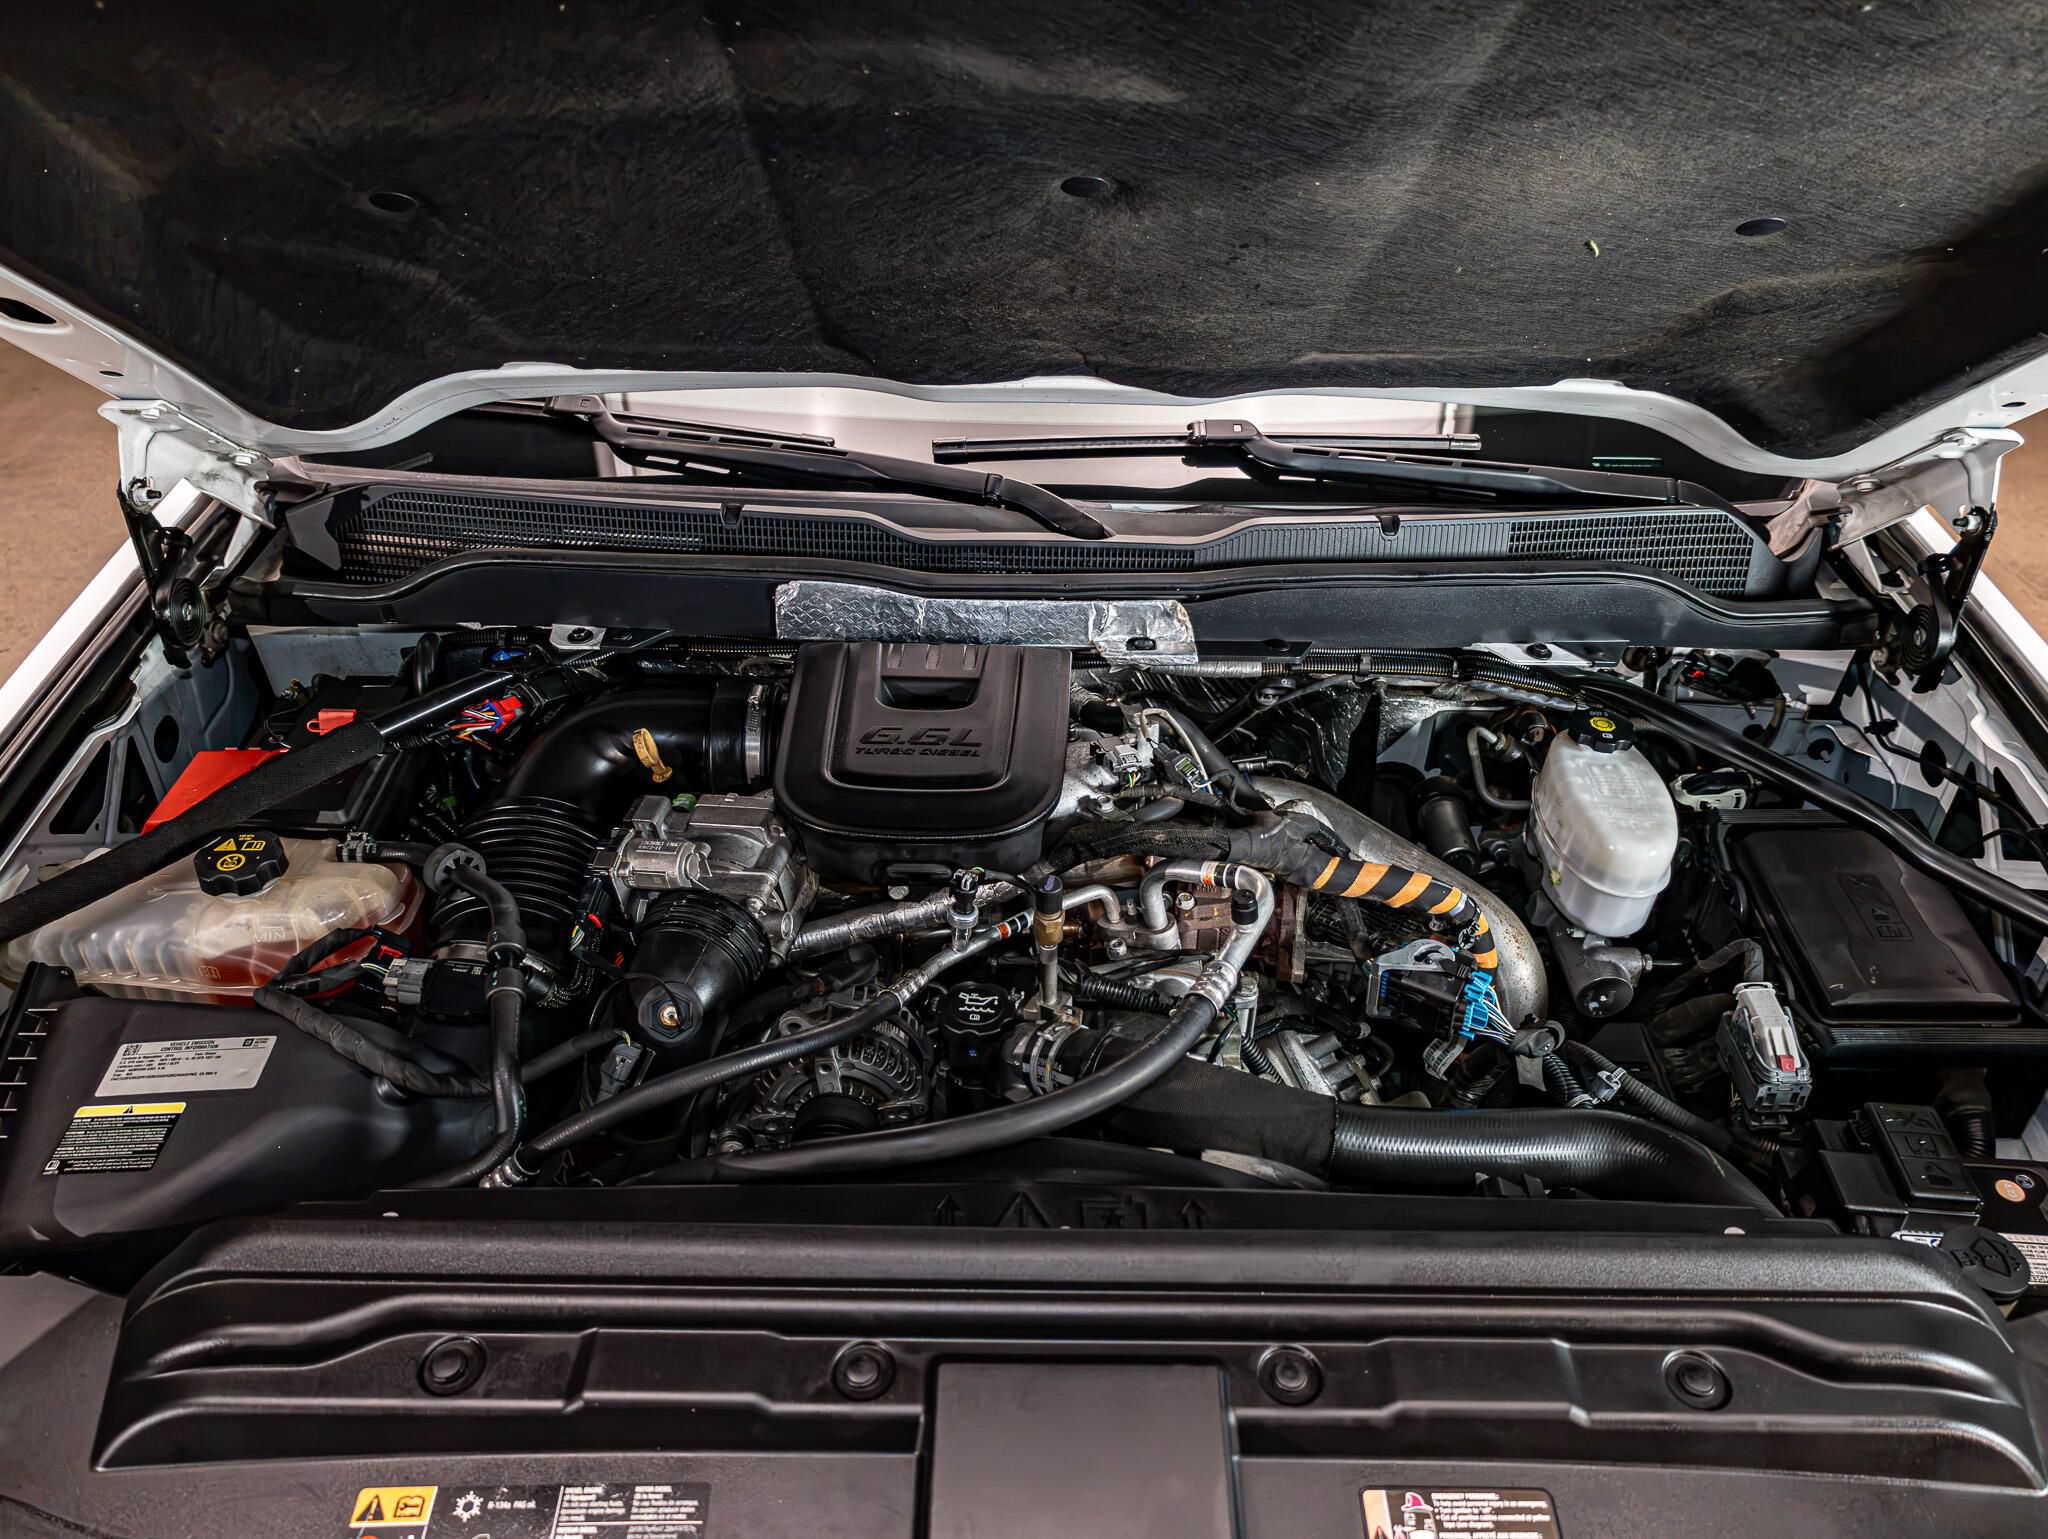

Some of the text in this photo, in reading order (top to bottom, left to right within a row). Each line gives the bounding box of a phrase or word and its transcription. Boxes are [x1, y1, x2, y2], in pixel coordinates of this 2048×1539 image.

[859, 726, 982, 747] 6.6L
[855, 747, 980, 757] TURBO DIESEL
